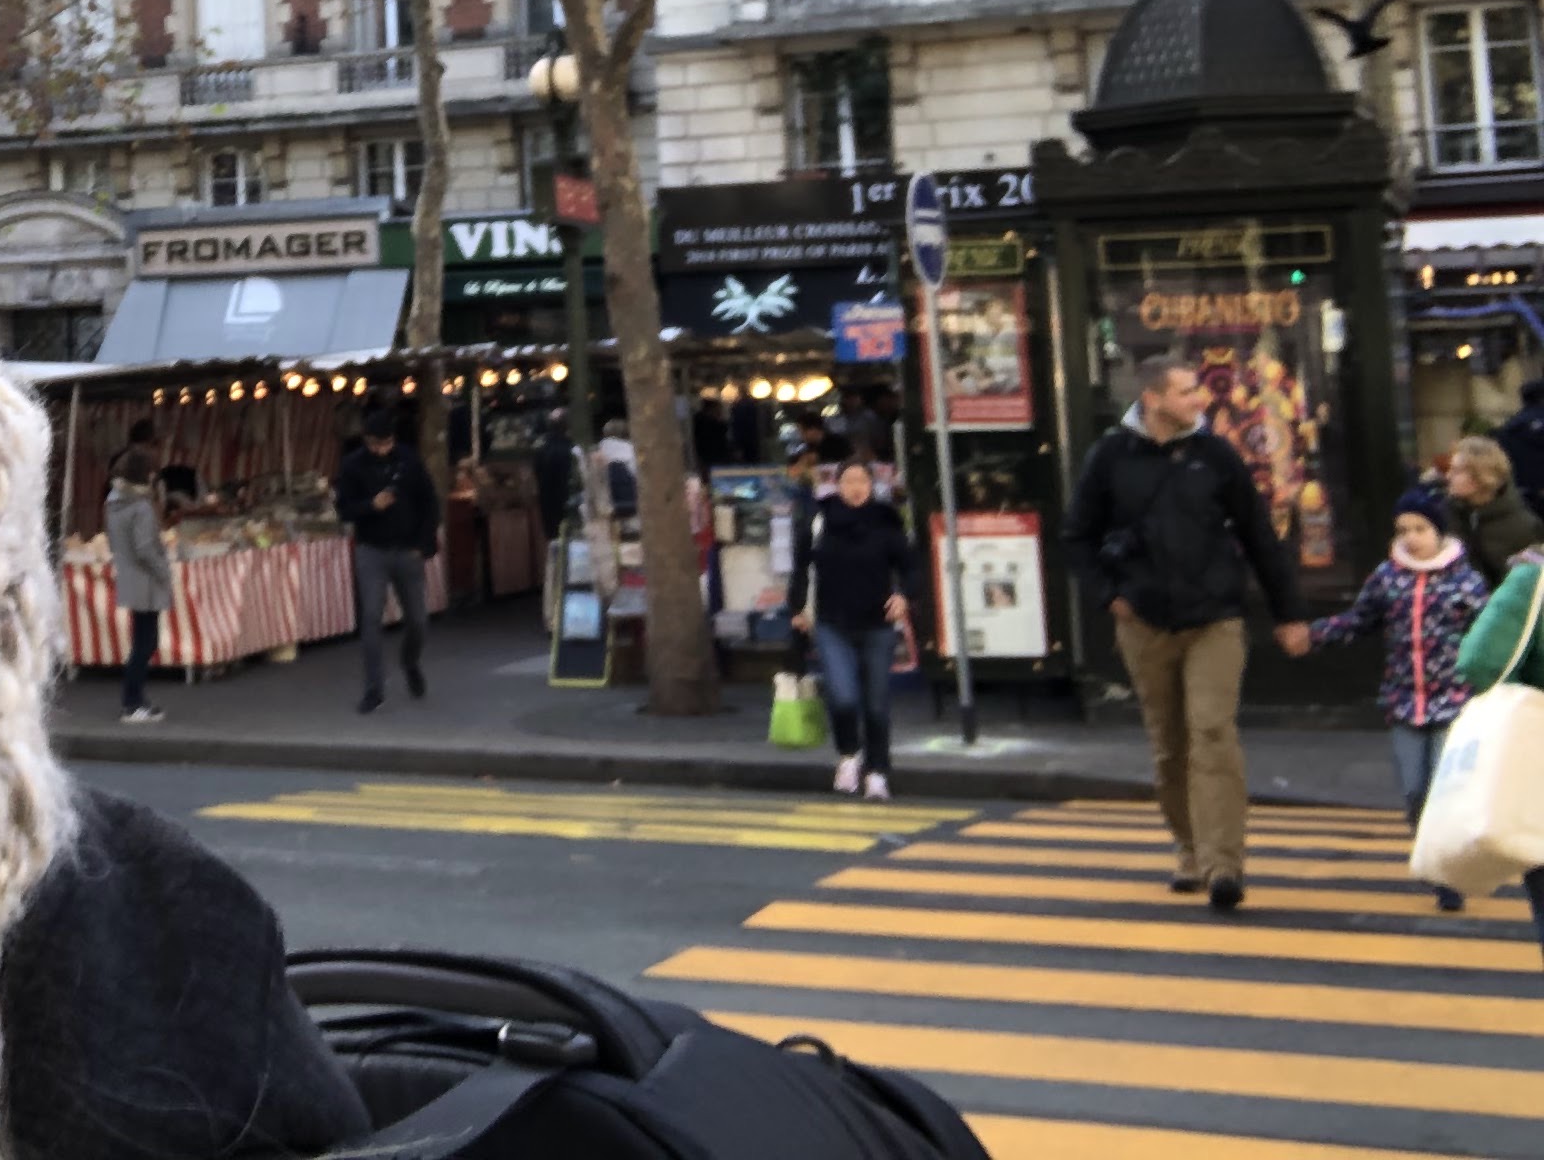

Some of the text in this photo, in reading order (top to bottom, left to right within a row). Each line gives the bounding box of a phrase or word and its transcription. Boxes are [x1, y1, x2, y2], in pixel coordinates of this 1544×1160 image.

[852, 181, 897, 214] 1er
[934, 175, 987, 209] rix
[142, 231, 367, 265] FROMAGER
